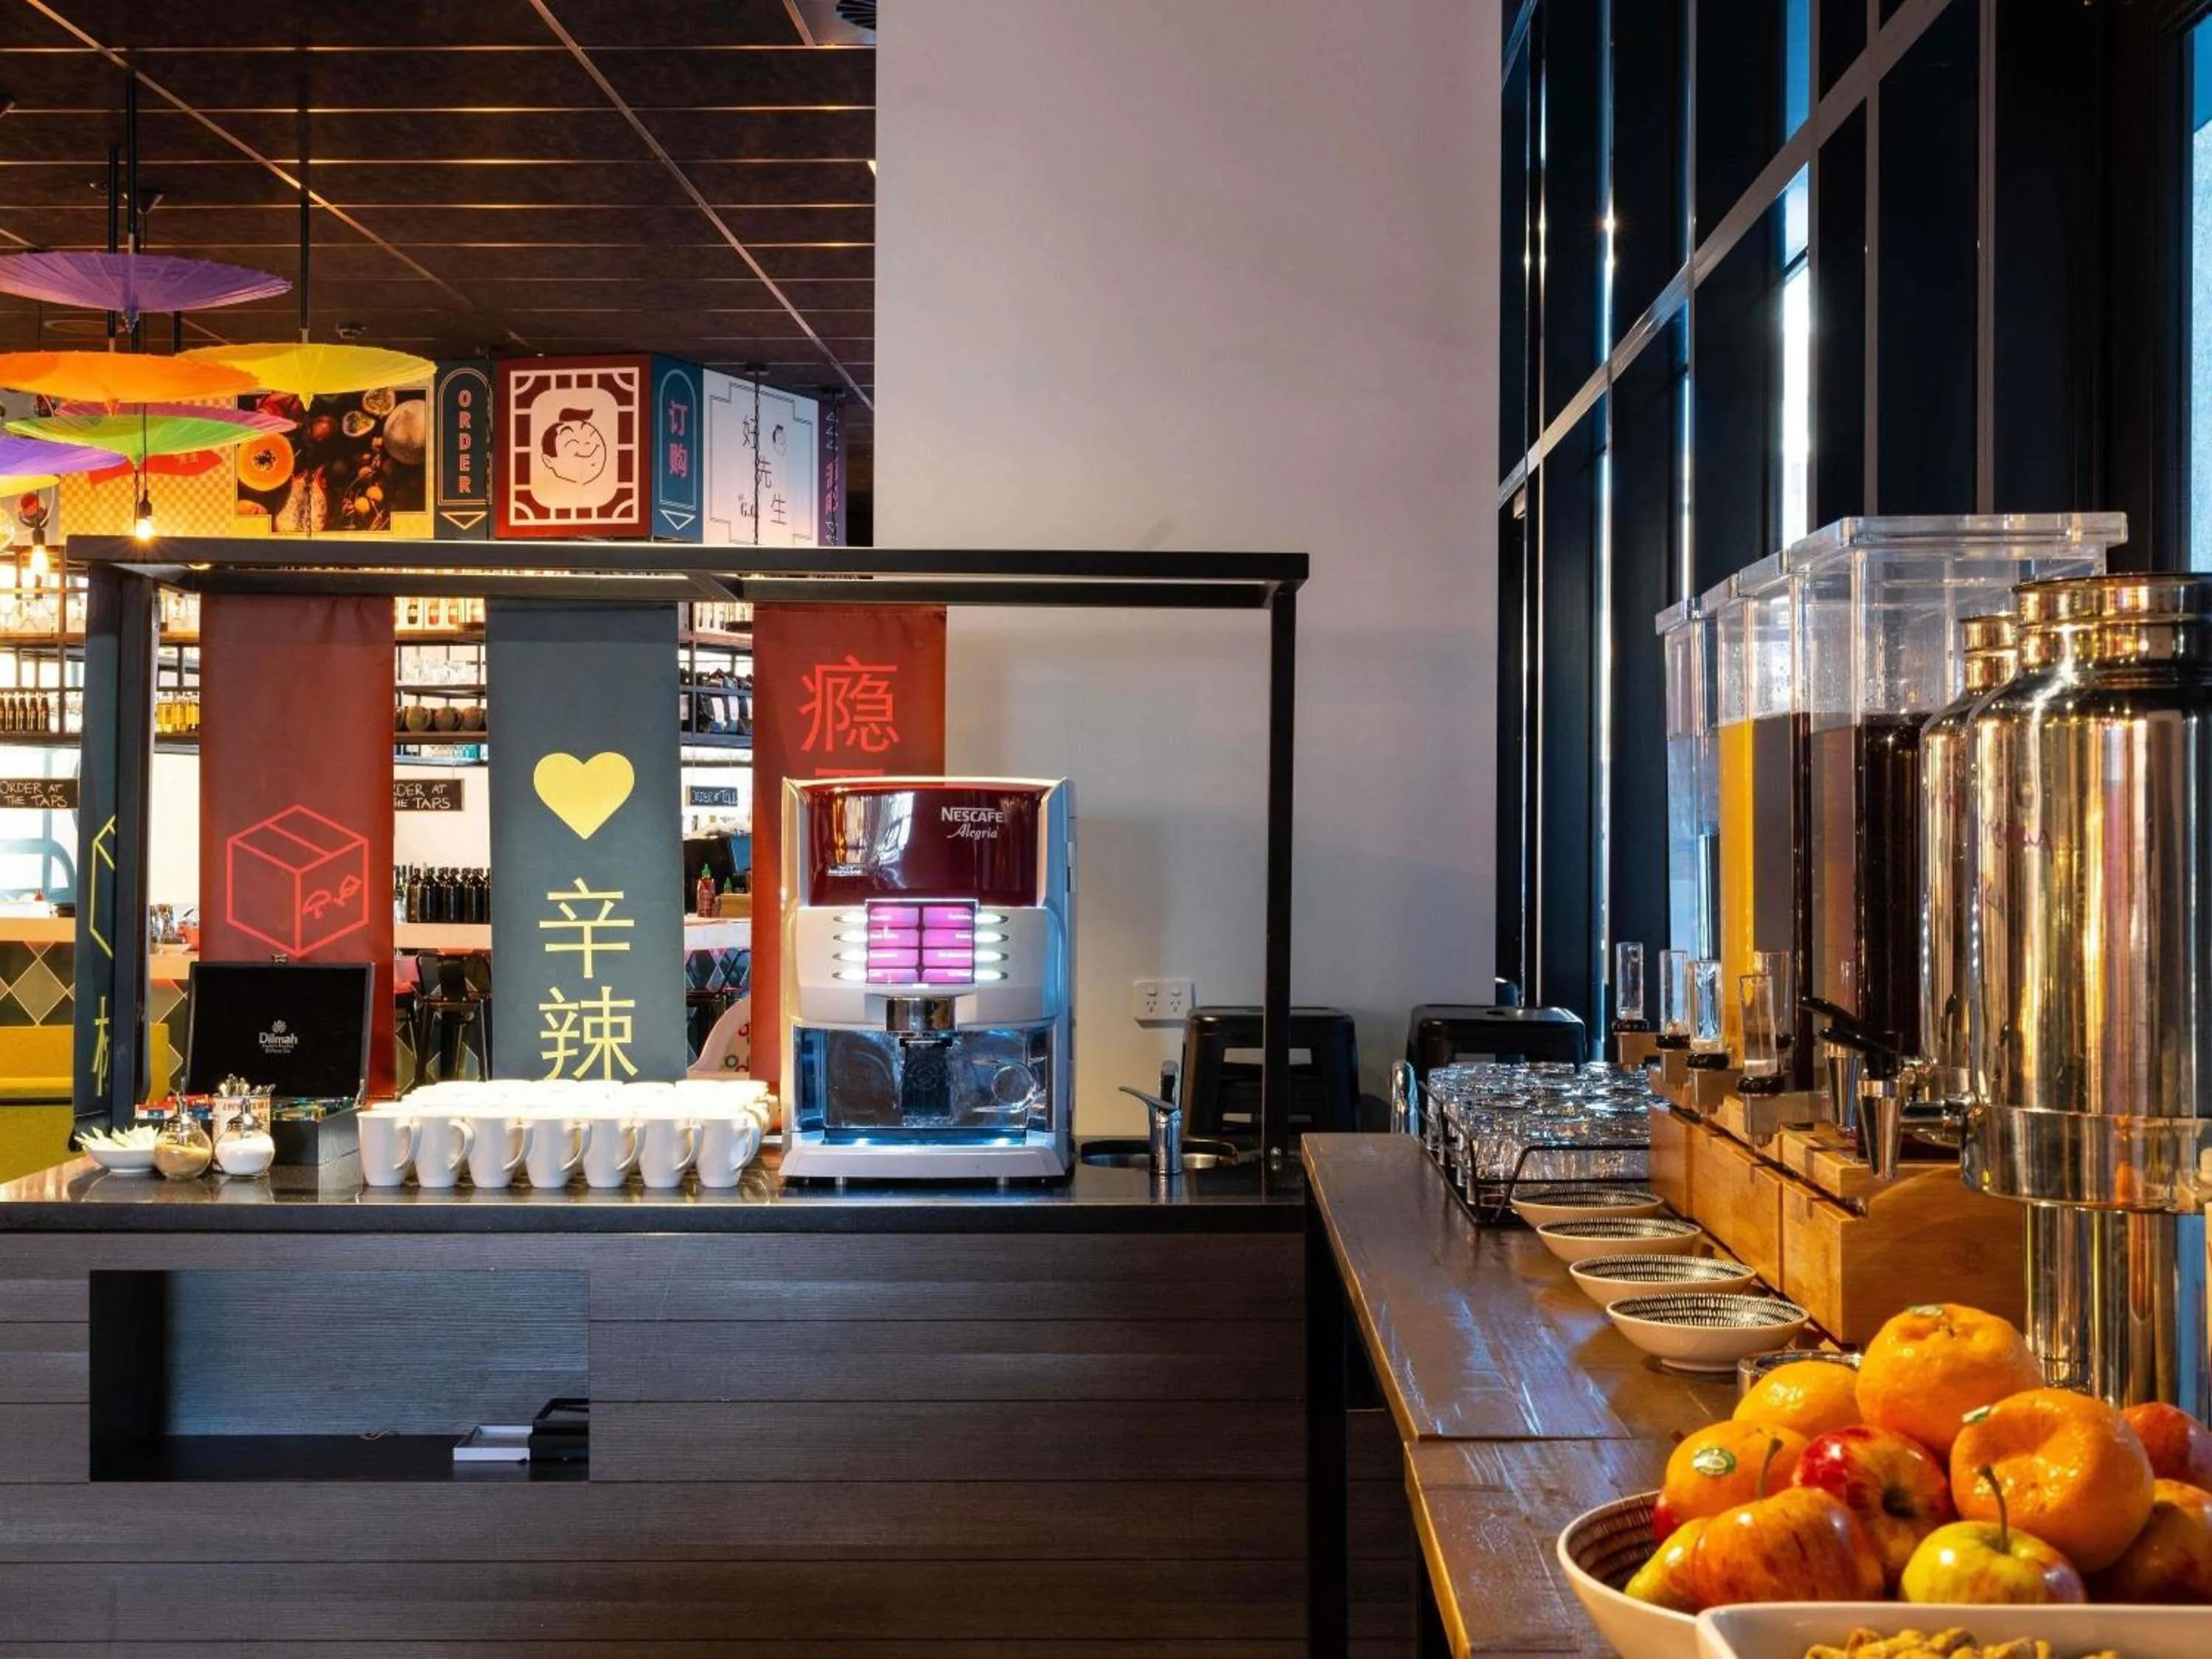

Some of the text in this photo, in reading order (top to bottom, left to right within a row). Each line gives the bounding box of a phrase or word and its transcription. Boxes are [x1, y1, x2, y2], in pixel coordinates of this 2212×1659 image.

[458, 389, 472, 493] ORDER
[667, 400, 688, 479] 订购
[0, 780, 64, 794] ORDER AT
[431, 784, 447, 795] AT
[4, 794, 68, 807] THE TAPS
[412, 796, 451, 809] TAPS
[946, 822, 999, 841] Alegria
[538, 877, 639, 1081] 辛辣
[259, 1032, 299, 1045] Dilmah
